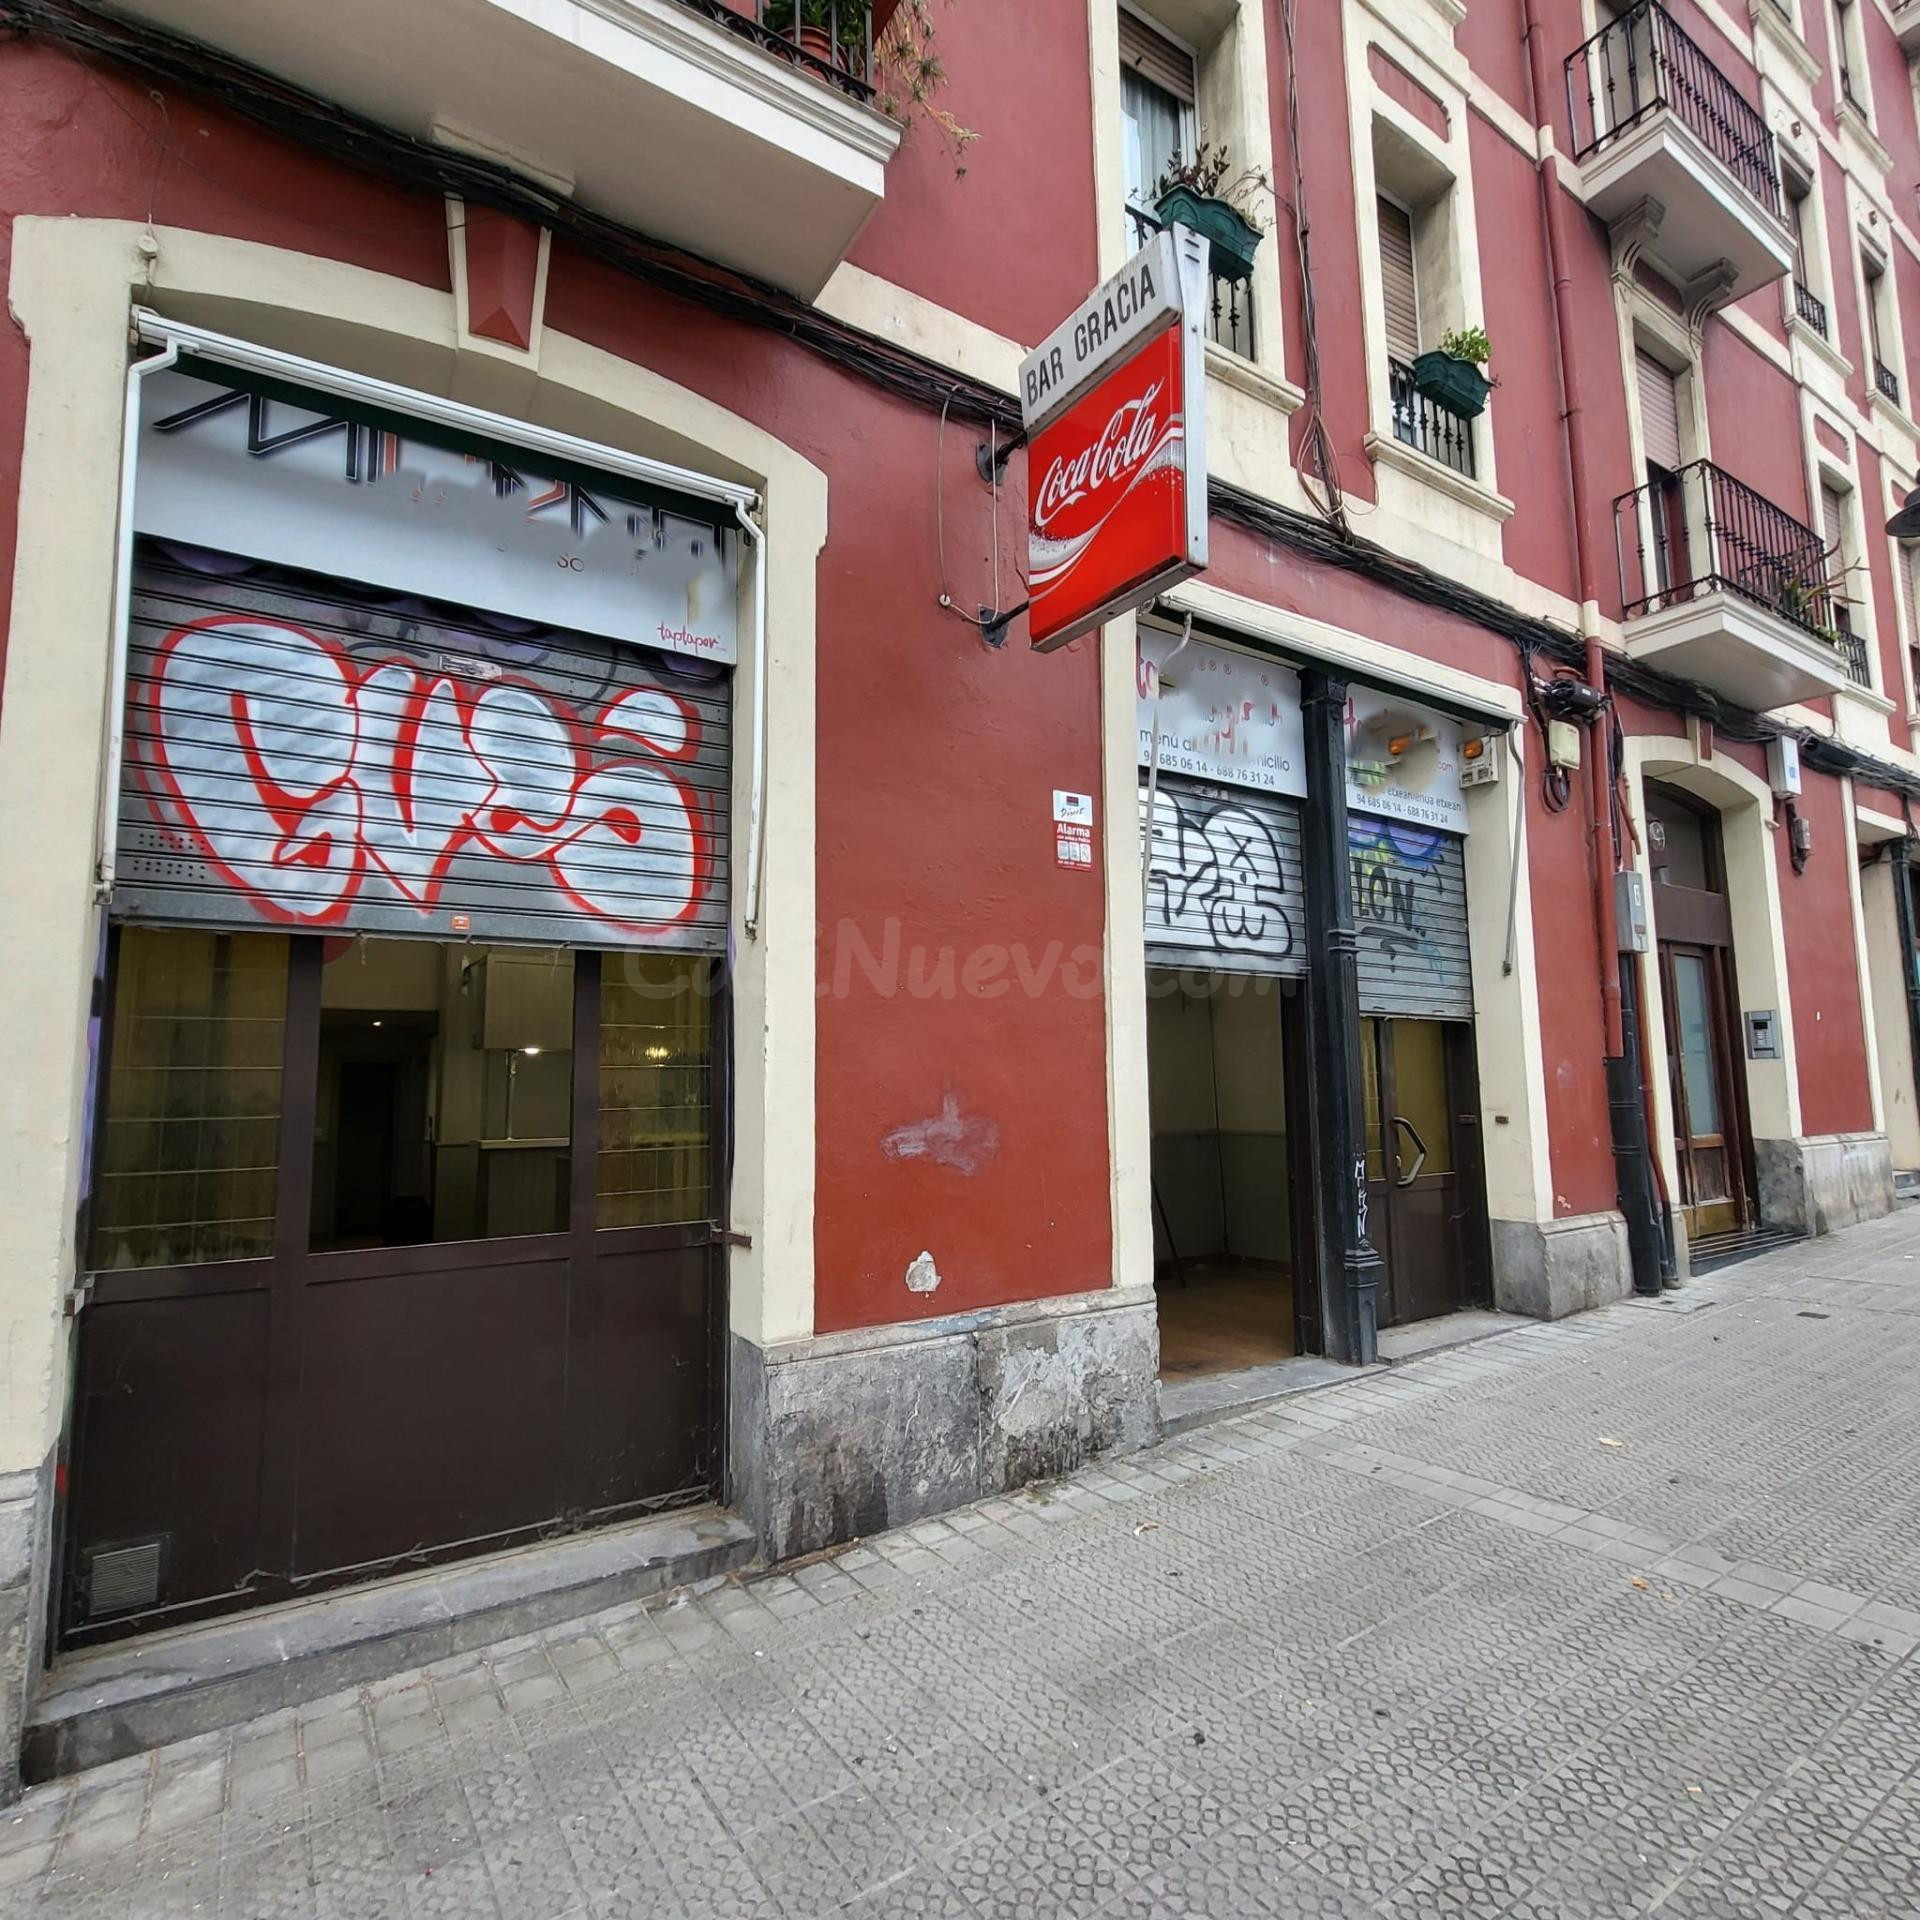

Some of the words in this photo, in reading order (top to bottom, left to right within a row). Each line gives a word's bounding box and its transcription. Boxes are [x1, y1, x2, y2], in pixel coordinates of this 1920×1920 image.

[1026, 346, 1064, 407] BAR
[1074, 263, 1156, 362] GRACIA
[1035, 377, 1165, 527] Coca-Cola
[1140, 729, 1179, 749] mnú
[1160, 753, 1178, 767] 685
[1181, 757, 1193, 770] 06
[1197, 760, 1208, 773] 14
[1216, 765, 1234, 778] 688
[1237, 768, 1248, 780] 76
[1250, 771, 1260, 783] 31
[1264, 774, 1275, 785] 24
[1057, 823, 1090, 838] Alarma
